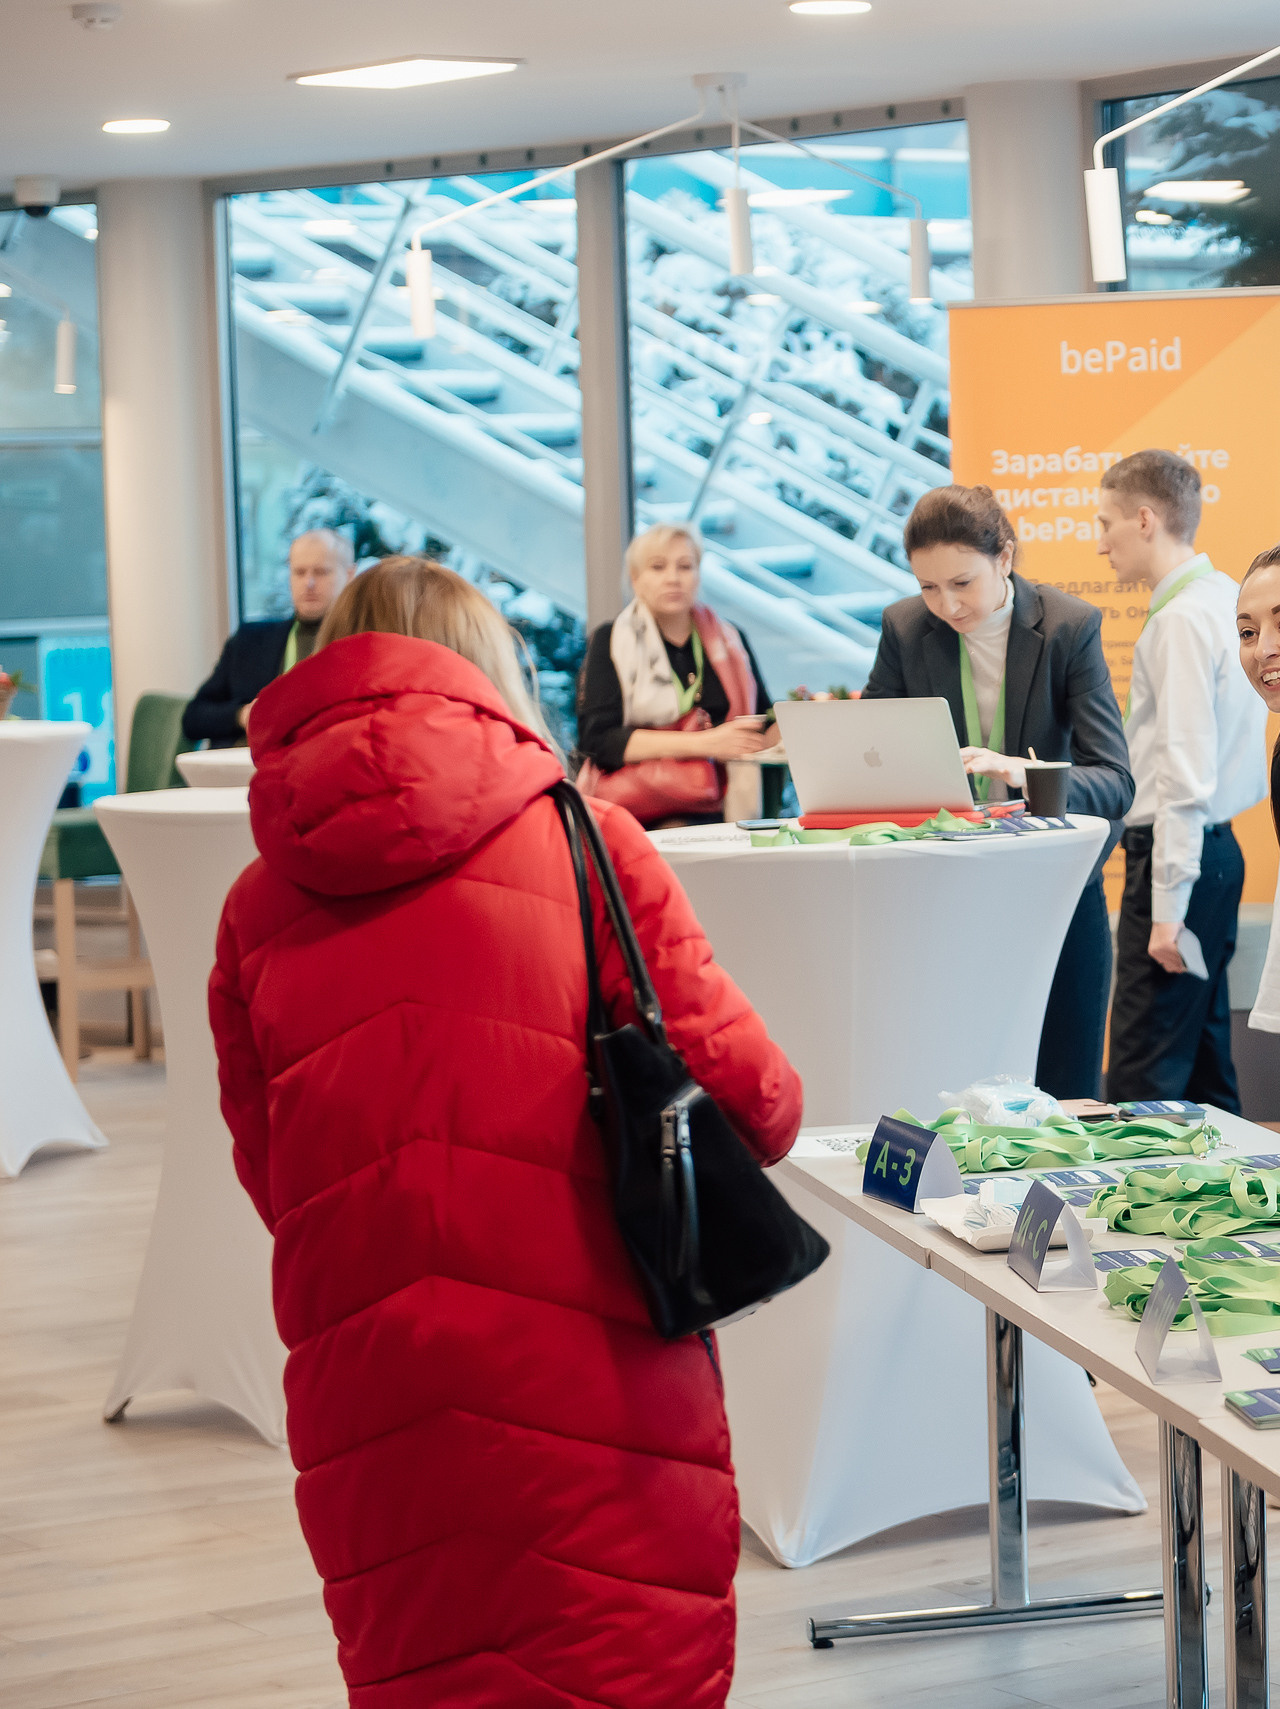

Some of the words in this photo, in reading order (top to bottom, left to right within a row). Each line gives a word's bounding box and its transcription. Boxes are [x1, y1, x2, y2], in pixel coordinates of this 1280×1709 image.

[1060, 336, 1182, 375] bePaid
[991, 444, 1230, 479] Зарабатйте
[994, 484, 1221, 511] дистано
[1018, 514, 1101, 542] bePai
